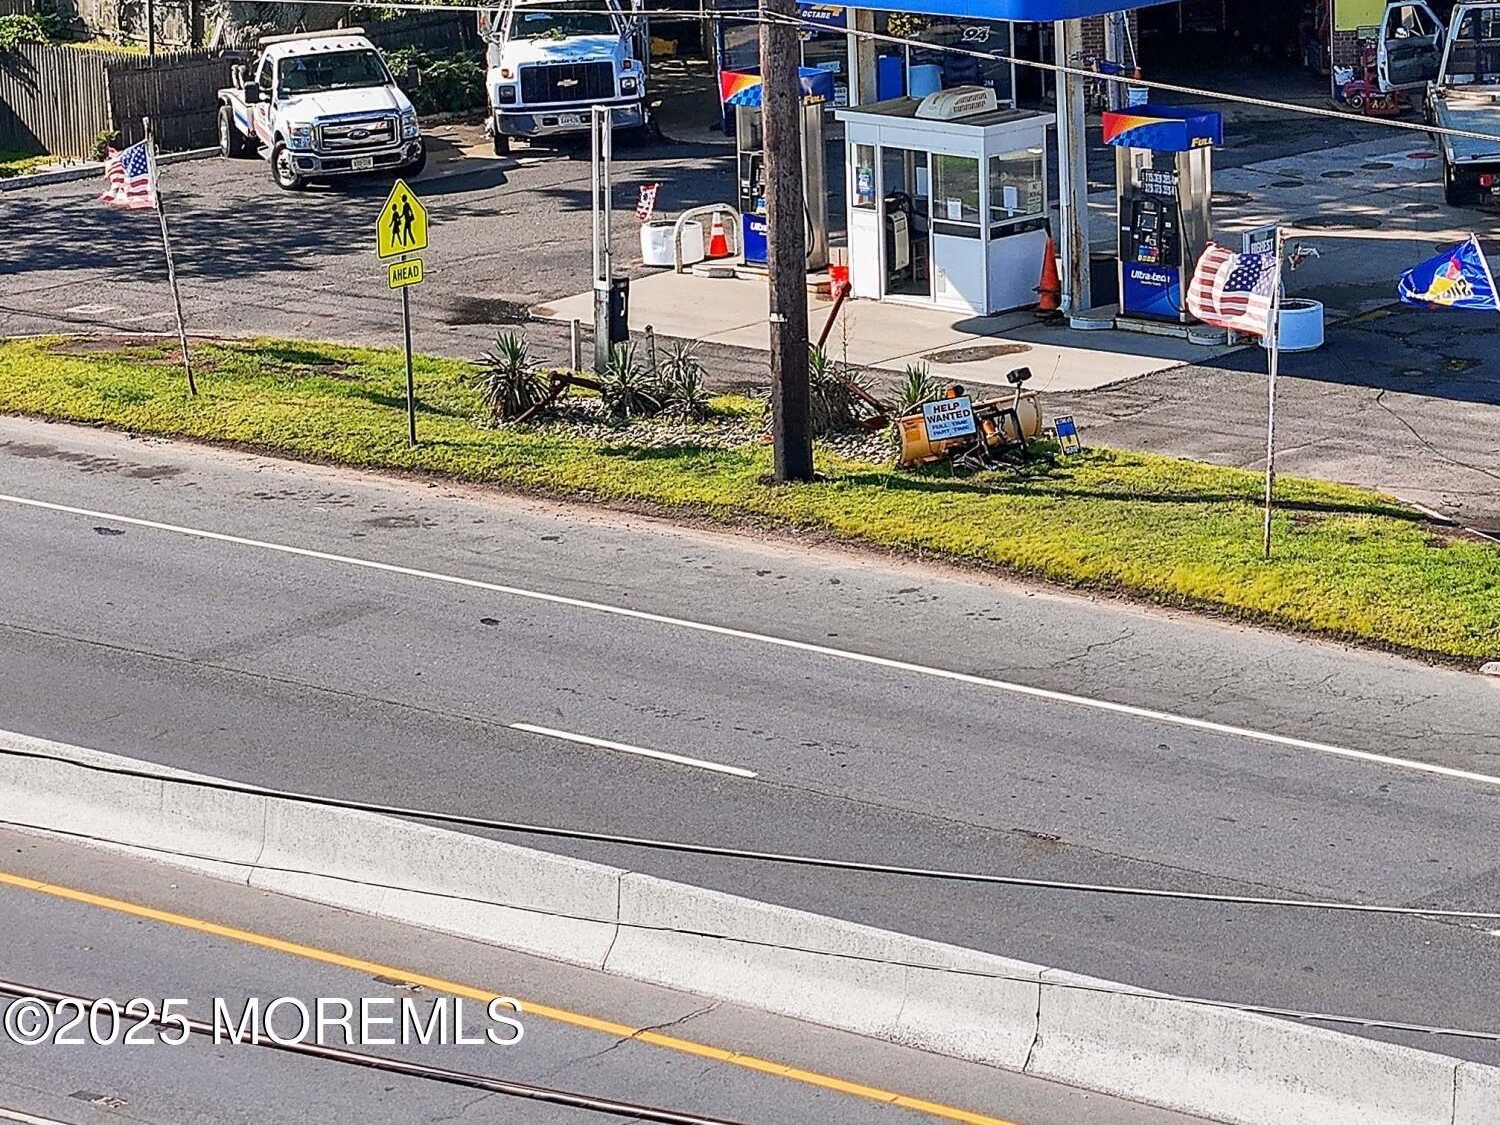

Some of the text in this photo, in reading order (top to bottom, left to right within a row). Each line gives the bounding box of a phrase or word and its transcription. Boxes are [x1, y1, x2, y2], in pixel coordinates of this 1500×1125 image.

[802, 10, 831, 19] OCTANE
[961, 26, 990, 43] 94
[393, 265, 419, 282] AHEAD
[933, 402, 960, 414] HELP
[927, 409, 971, 424] WANTED
[952, 419, 968, 427] TIME
